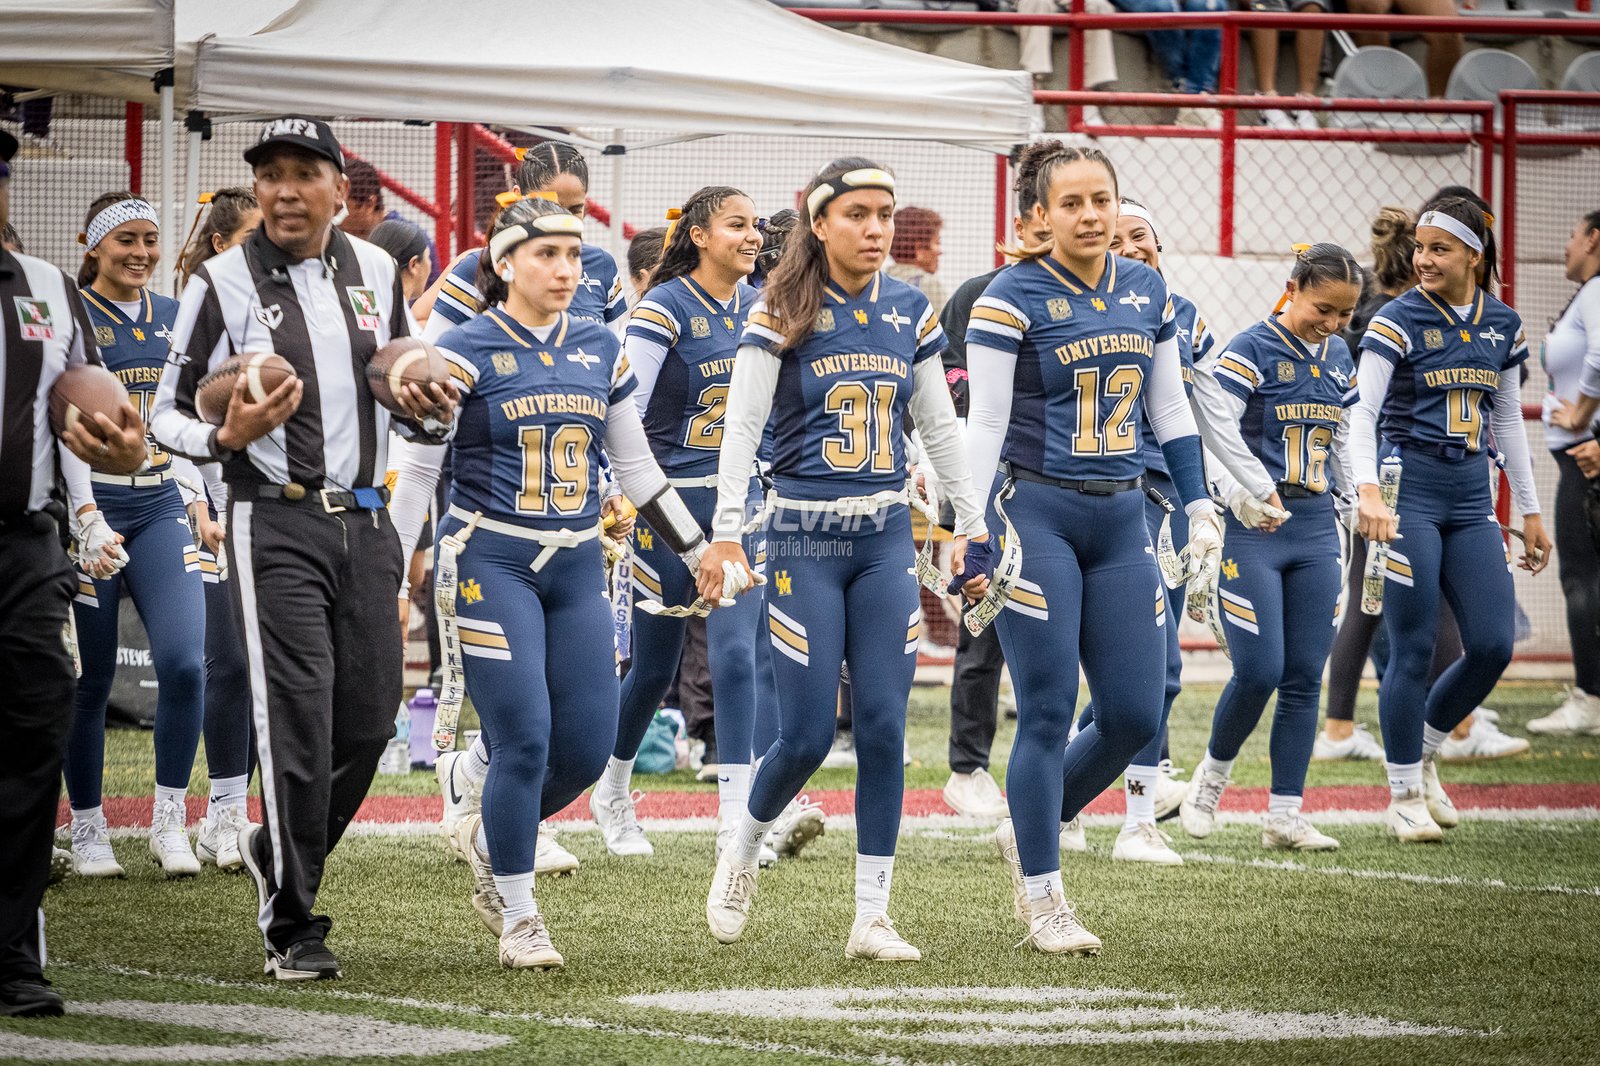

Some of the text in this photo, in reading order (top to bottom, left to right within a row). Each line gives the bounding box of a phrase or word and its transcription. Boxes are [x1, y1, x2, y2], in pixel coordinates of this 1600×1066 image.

[811, 353, 908, 379] UNIVERSIDAD
[1055, 333, 1154, 366] UNIVERSIDAD
[501, 393, 607, 421] UNIVERSIDAD
[822, 381, 897, 473] 31
[1072, 364, 1144, 456] 12
[1446, 388, 1485, 452] 4
[515, 424, 593, 515] 19
[1281, 424, 1335, 494] 16
[444, 619, 457, 700] PUMAS
